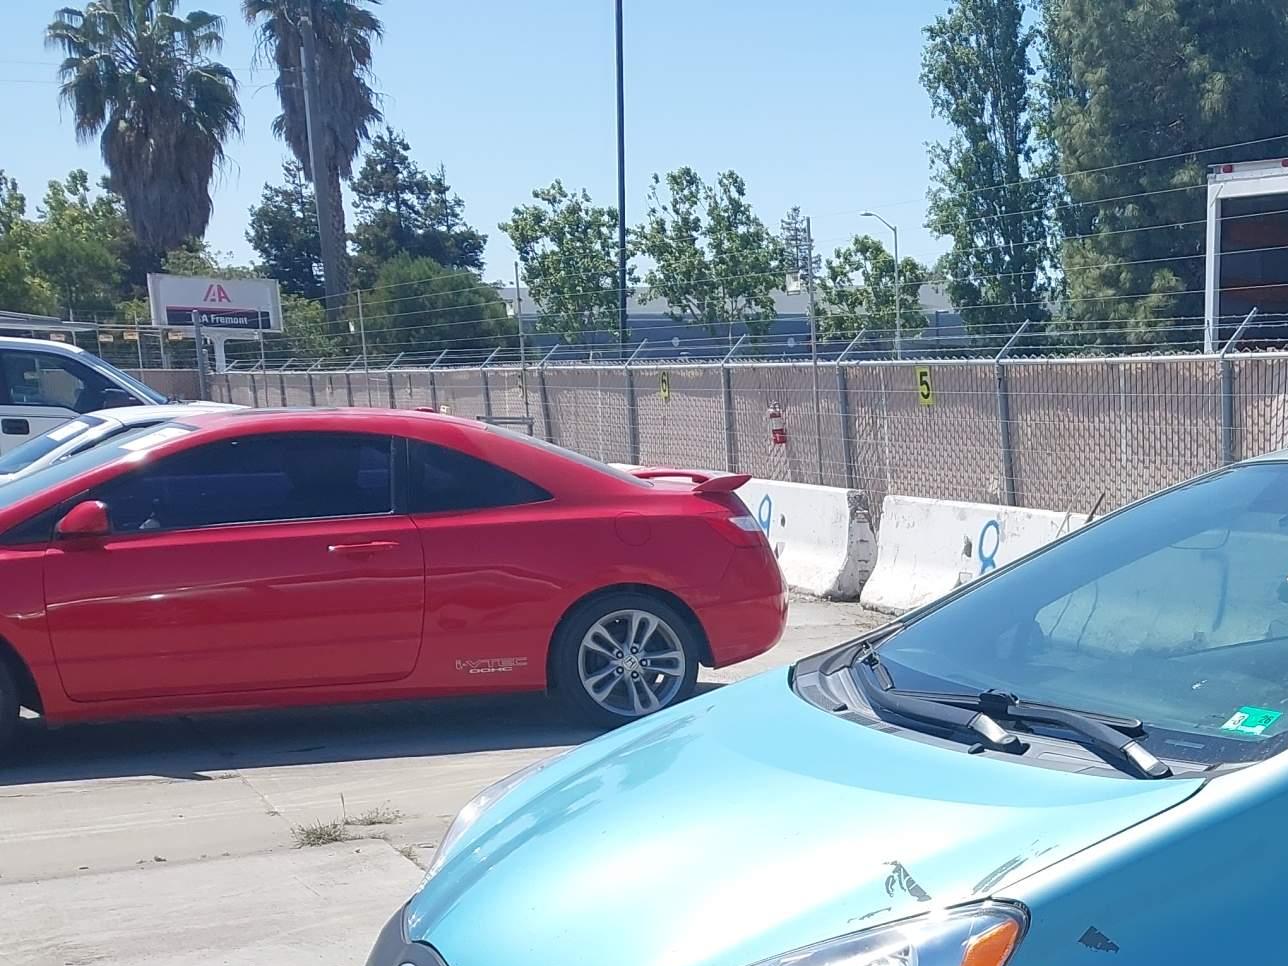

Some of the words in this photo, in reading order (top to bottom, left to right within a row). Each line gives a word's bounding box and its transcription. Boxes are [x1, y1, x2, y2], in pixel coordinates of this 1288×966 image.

[210, 314, 249, 325] Fremont
[661, 371, 667, 393] 6
[919, 371, 930, 400] 5
[758, 493, 772, 538] 9
